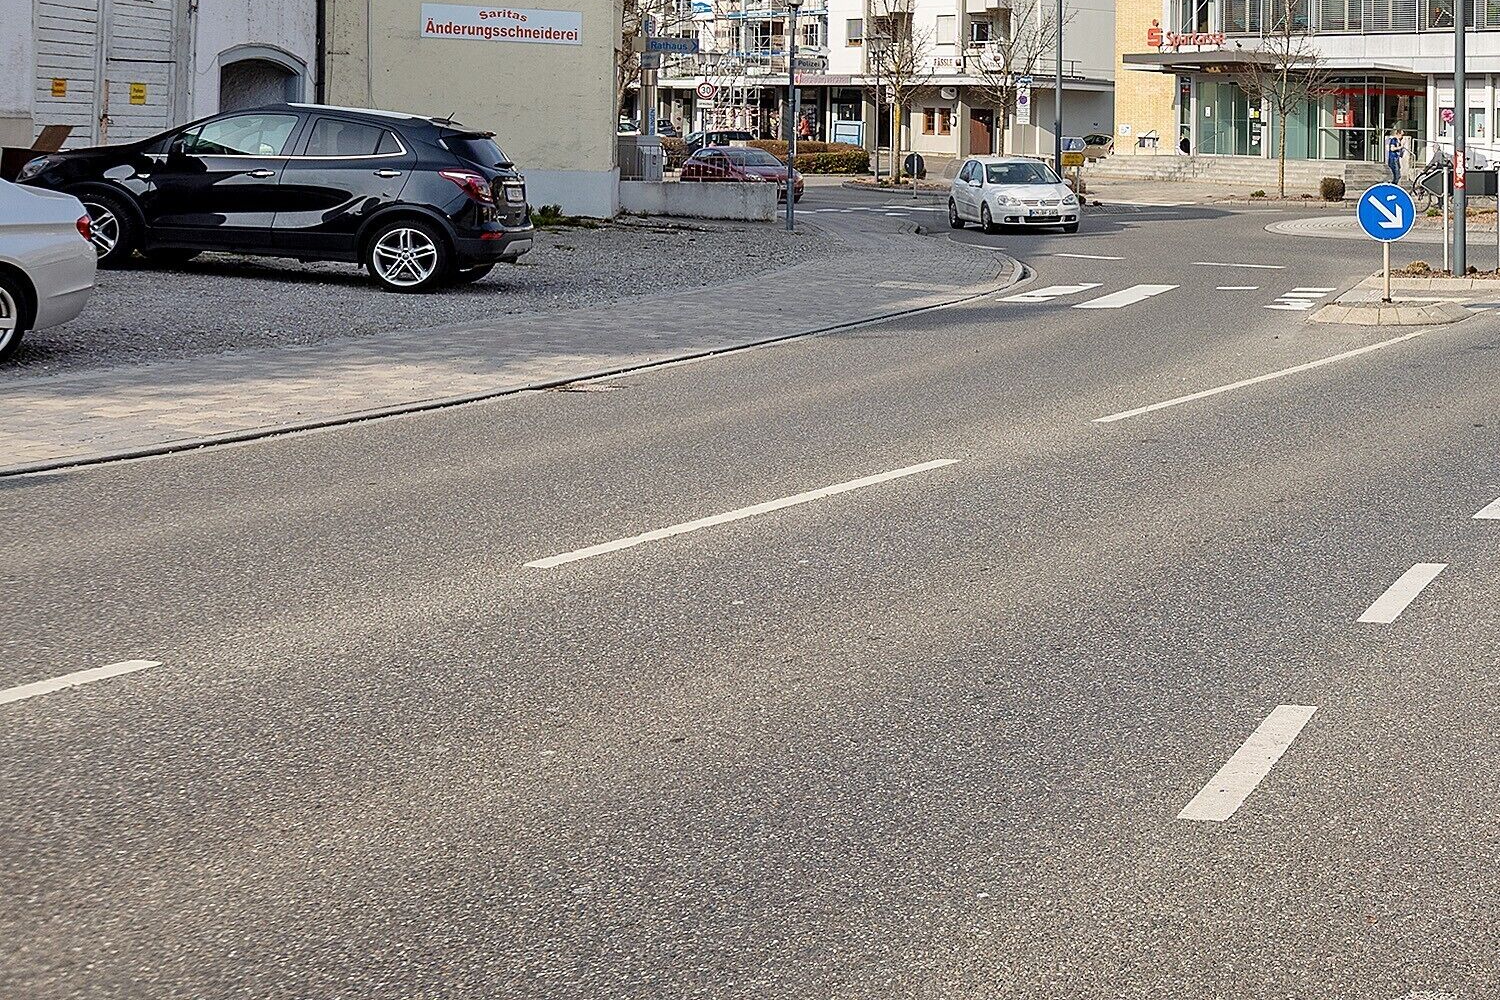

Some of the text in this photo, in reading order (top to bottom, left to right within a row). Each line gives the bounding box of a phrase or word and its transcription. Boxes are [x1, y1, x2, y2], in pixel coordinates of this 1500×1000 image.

[478, 8, 528, 22] Saritas
[425, 18, 578, 39] Änderungsschneiderei
[1166, 30, 1226, 48] Sparkasse
[650, 41, 688, 50] Rathaus
[798, 59, 820, 67] Polizei
[701, 86, 710, 94] 30
